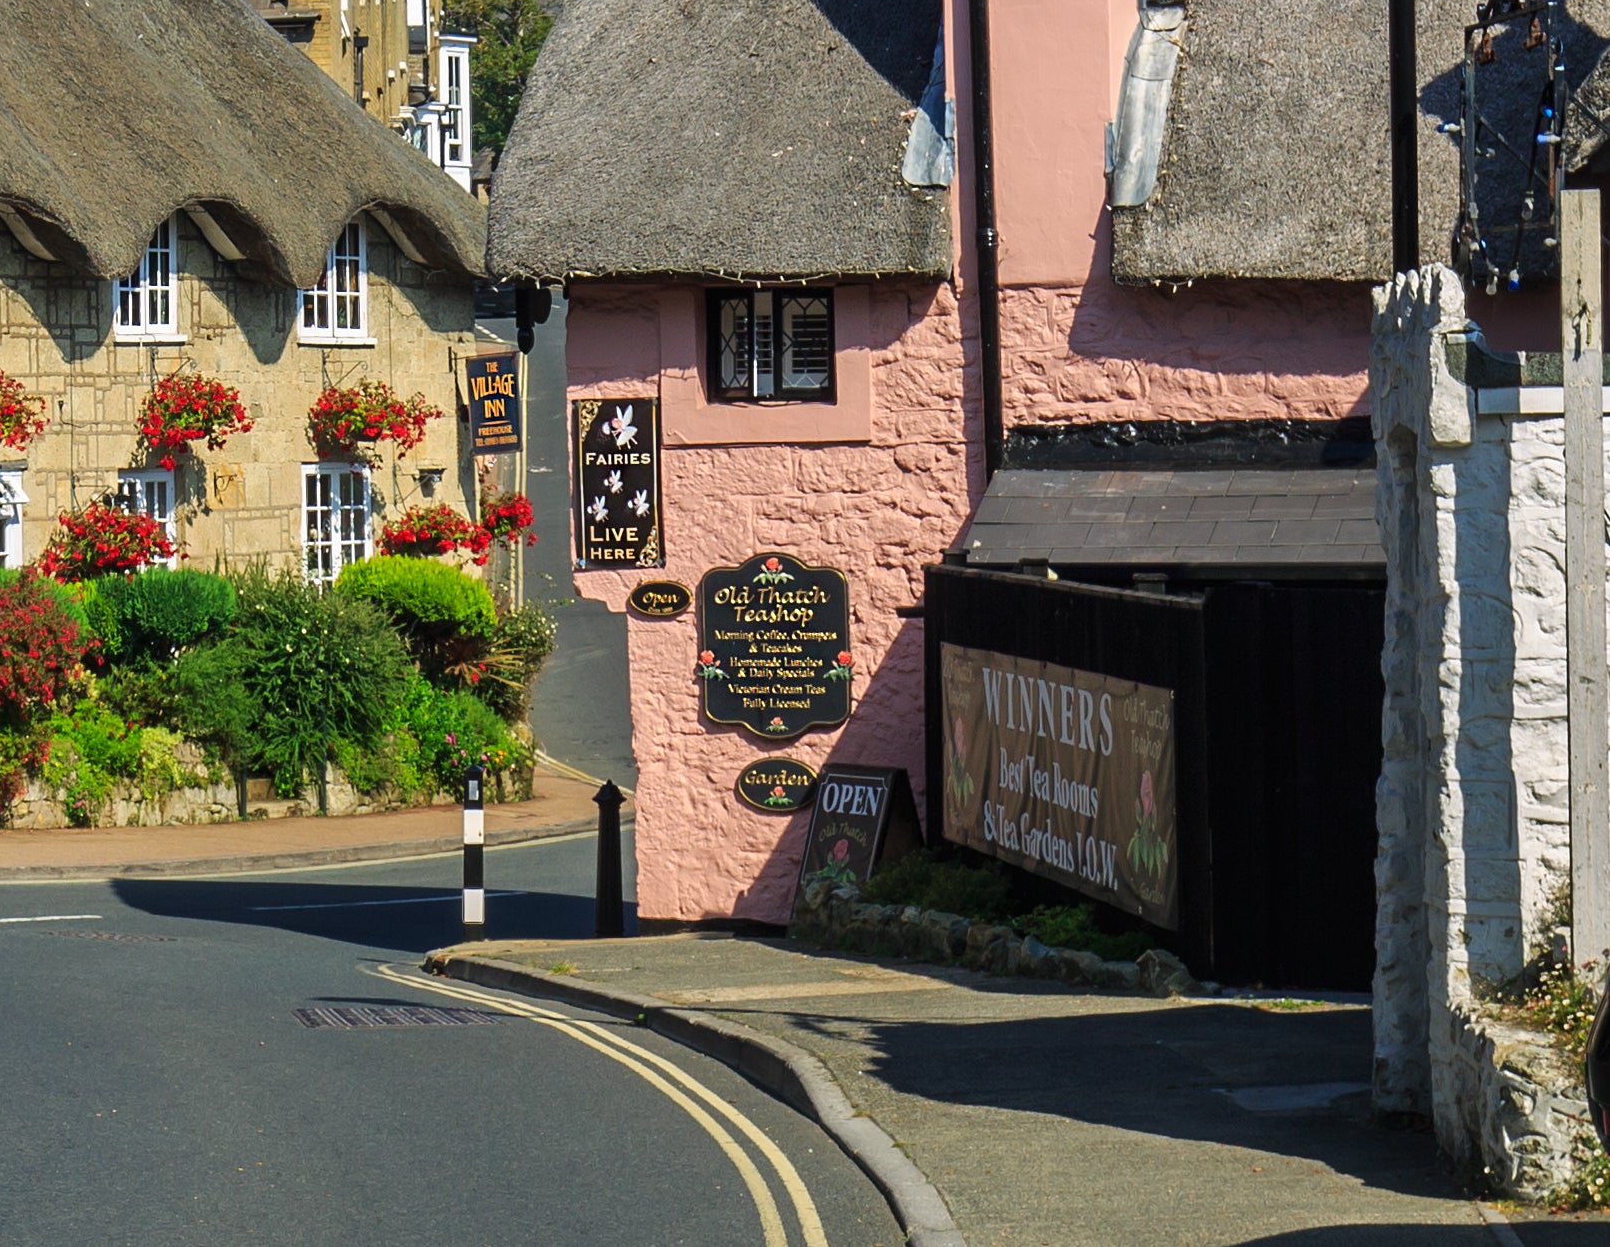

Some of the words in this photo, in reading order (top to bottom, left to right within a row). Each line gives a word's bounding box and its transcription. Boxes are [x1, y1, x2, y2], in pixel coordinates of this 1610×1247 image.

[485, 361, 499, 373] THE
[470, 373, 515, 401] VILLAGE
[484, 398, 505, 419] INN
[585, 452, 652, 465] FAIRIES
[589, 526, 639, 542] LIVE
[590, 547, 636, 560] HERE
[642, 592, 680, 607] Open
[714, 585, 755, 605] Old
[757, 585, 831, 604] Thatch
[734, 604, 814, 627] Teashop
[714, 629, 754, 642] Morning
[755, 629, 790, 641] Coffee,
[791, 629, 838, 642] Crumpets
[748, 643, 758, 653] &
[760, 643, 803, 653] Teacakes
[730, 656, 782, 667] Homemade
[783, 656, 823, 667] Lunches
[737, 668, 746, 678] &
[749, 667, 773, 679] Daily
[776, 668, 815, 679] Specials
[727, 683, 770, 694] Victorian
[771, 683, 803, 694] Cream
[804, 683, 826, 694] Teas
[742, 697, 766, 710] Fully
[769, 697, 811, 709] Licensed
[982, 667, 1114, 756] WINNERS
[744, 769, 812, 786] Garden
[999, 747, 1025, 794] Best
[1026, 755, 1050, 800] Tea
[1052, 761, 1099, 819] Rooms
[822, 782, 883, 816] OPEN
[1019, 812, 1075, 874] Gardens
